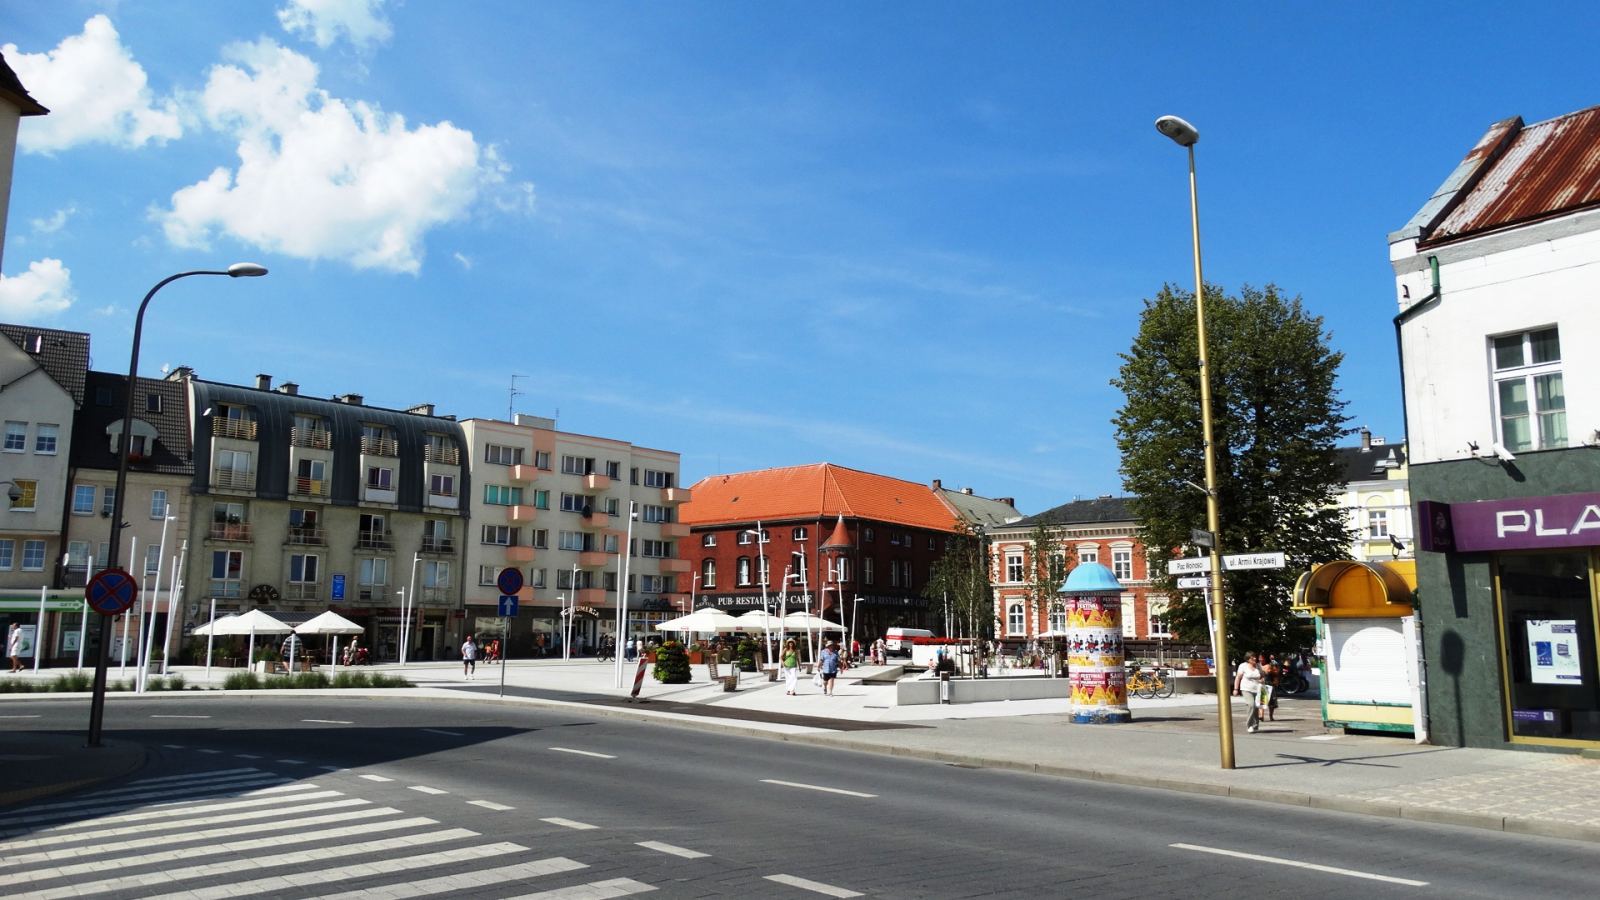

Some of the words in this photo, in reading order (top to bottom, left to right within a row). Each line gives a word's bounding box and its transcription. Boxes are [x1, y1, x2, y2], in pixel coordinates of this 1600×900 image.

[1238, 558, 1252, 567] Armii
[1253, 556, 1277, 567] Krajowej
[717, 597, 732, 606] PUB
[735, 594, 788, 605] RESTAUAN
